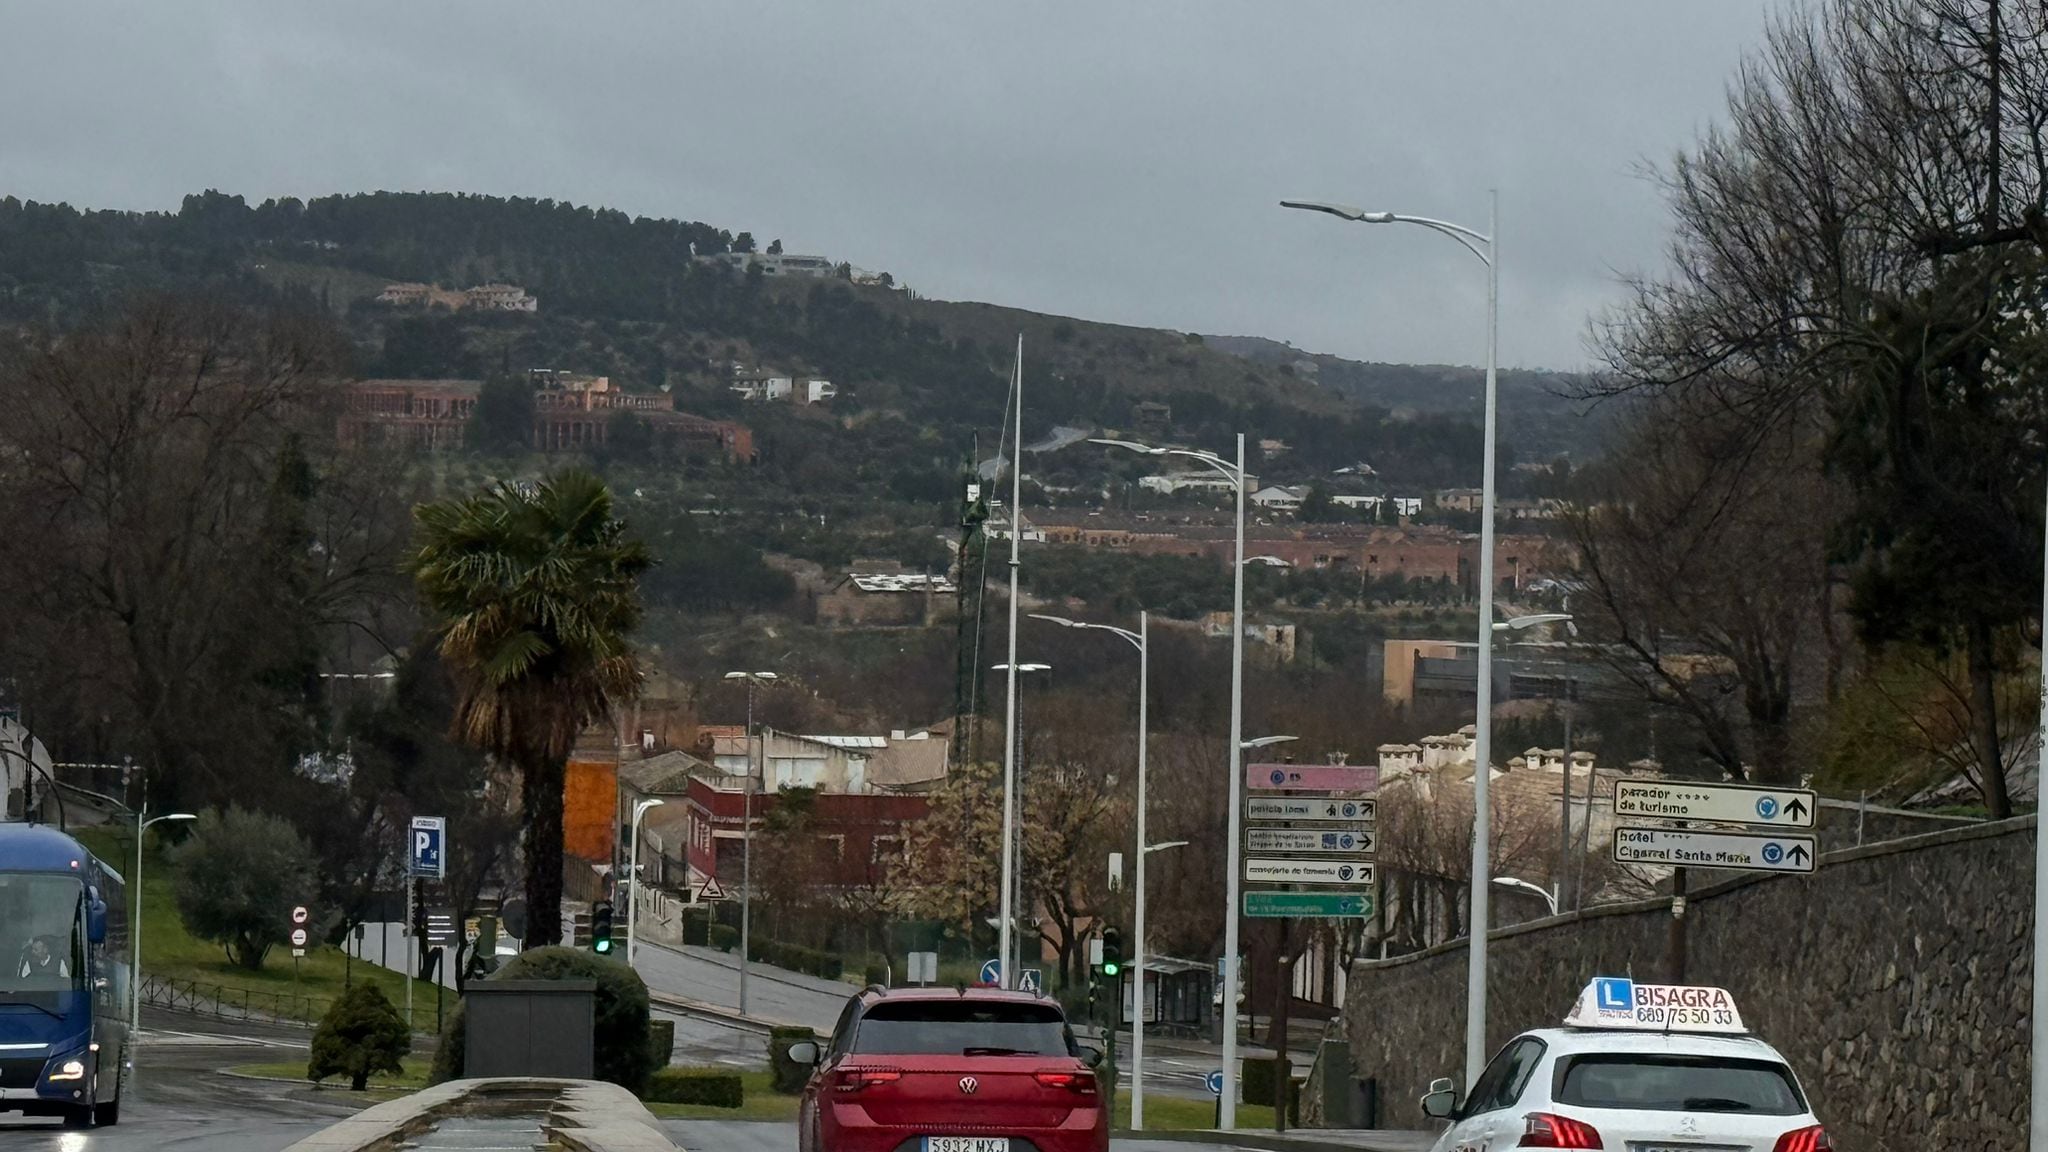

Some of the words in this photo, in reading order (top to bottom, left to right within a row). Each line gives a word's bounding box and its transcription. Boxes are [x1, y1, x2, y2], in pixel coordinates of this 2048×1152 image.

[1621, 788, 1671, 800] parador
[1620, 801, 1635, 811] de
[1640, 801, 1689, 814] turismo
[1620, 831, 1655, 843] hotel
[416, 831, 430, 858] P
[1619, 846, 1670, 860] Cigarral
[1674, 849, 1712, 861] Santa
[1604, 982, 1624, 1005] L
[1634, 987, 1729, 1009] BISAGRA
[1637, 1008, 1664, 1022] 689
[976, 1140, 1005, 1152] MXJ
